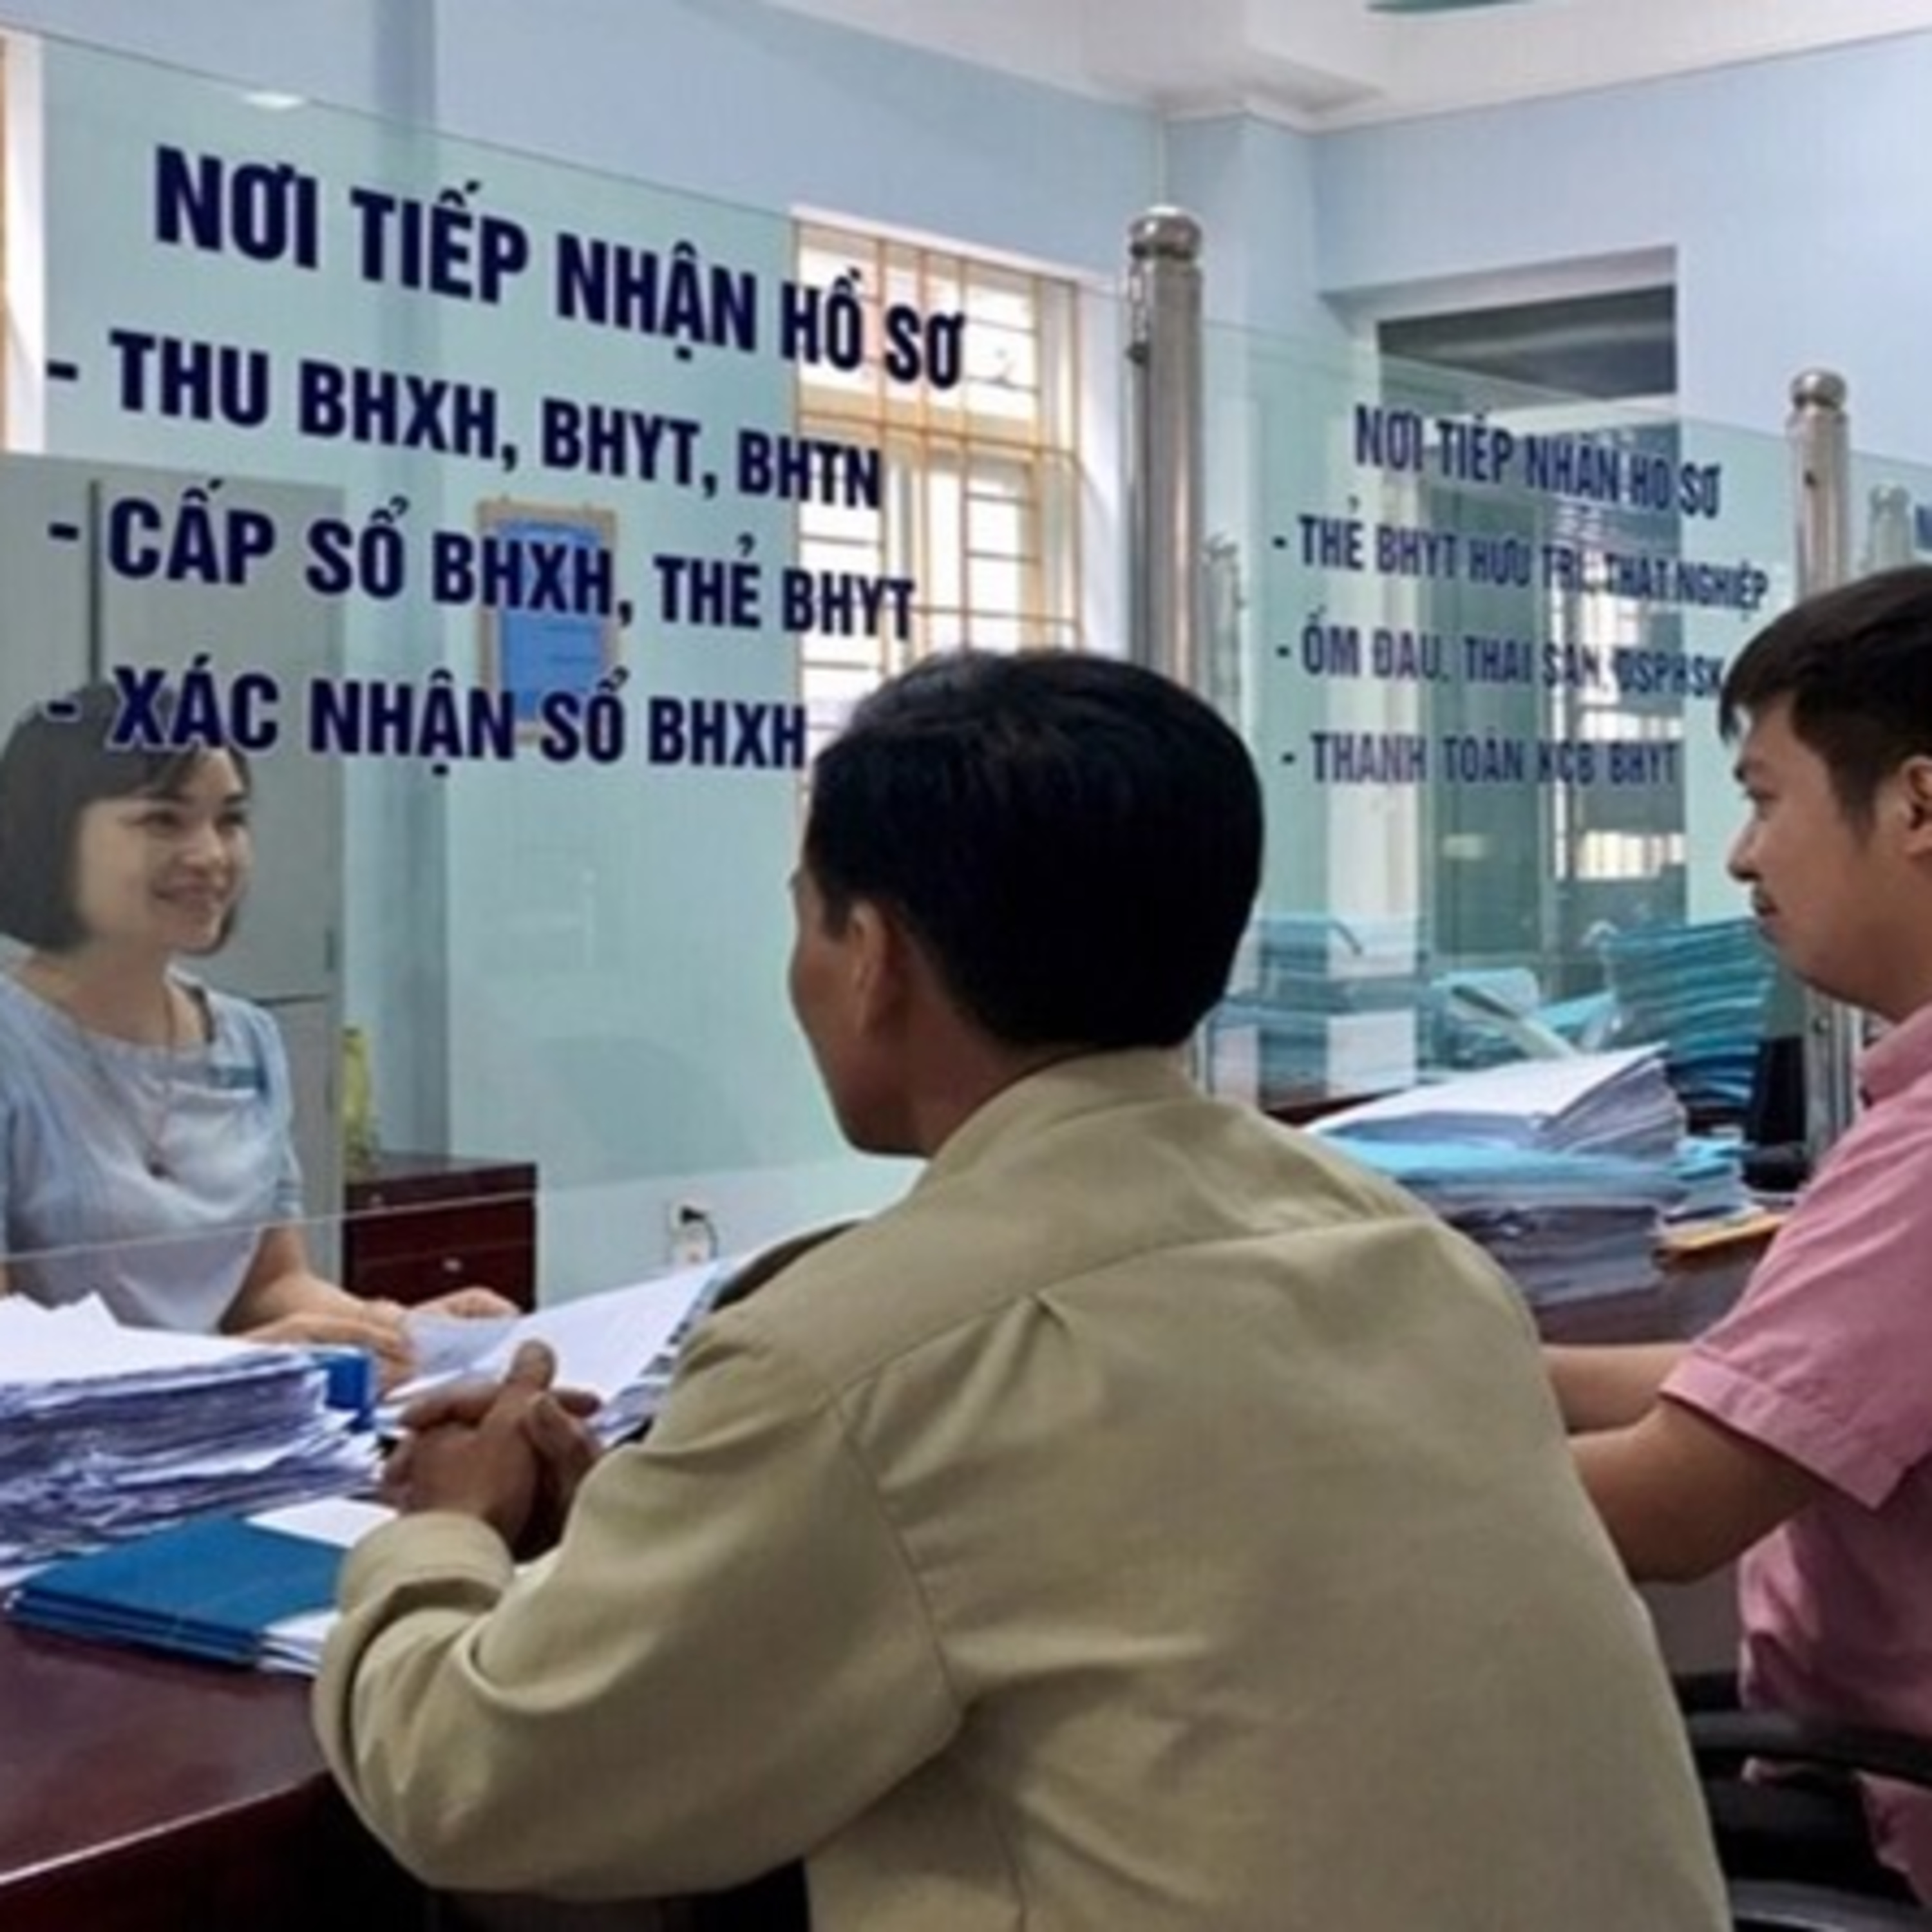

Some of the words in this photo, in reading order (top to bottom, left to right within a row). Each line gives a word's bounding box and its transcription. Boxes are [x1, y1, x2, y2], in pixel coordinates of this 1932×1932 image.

[155, 144, 318, 270] NƠI
[350, 178, 529, 305] TIẾP
[557, 231, 757, 362] NHẬN
[781, 267, 863, 372] HỒ
[884, 305, 966, 390] SƠ
[109, 328, 269, 428] THU
[299, 358, 518, 473] BHXH,
[542, 397, 717, 498] BHYT,
[738, 428, 883, 510] BHTN
[1356, 404, 1423, 472] NƠI
[1678, 461, 1721, 518] SƠ
[108, 478, 276, 586] CẤP
[305, 495, 411, 600] SỔ
[433, 530, 634, 627] BHXH,
[654, 533, 761, 630] THẺ
[782, 567, 916, 641] BHYT
[1298, 494, 1363, 571] THẺ
[1376, 525, 1456, 578] BHYT
[1302, 604, 1360, 677] ỐM
[109, 653, 281, 752] XÁC
[308, 668, 515, 777] NHẬN
[538, 666, 631, 764] SỔ
[648, 696, 806, 771] BHXH
[1311, 732, 1426, 783] THANH
